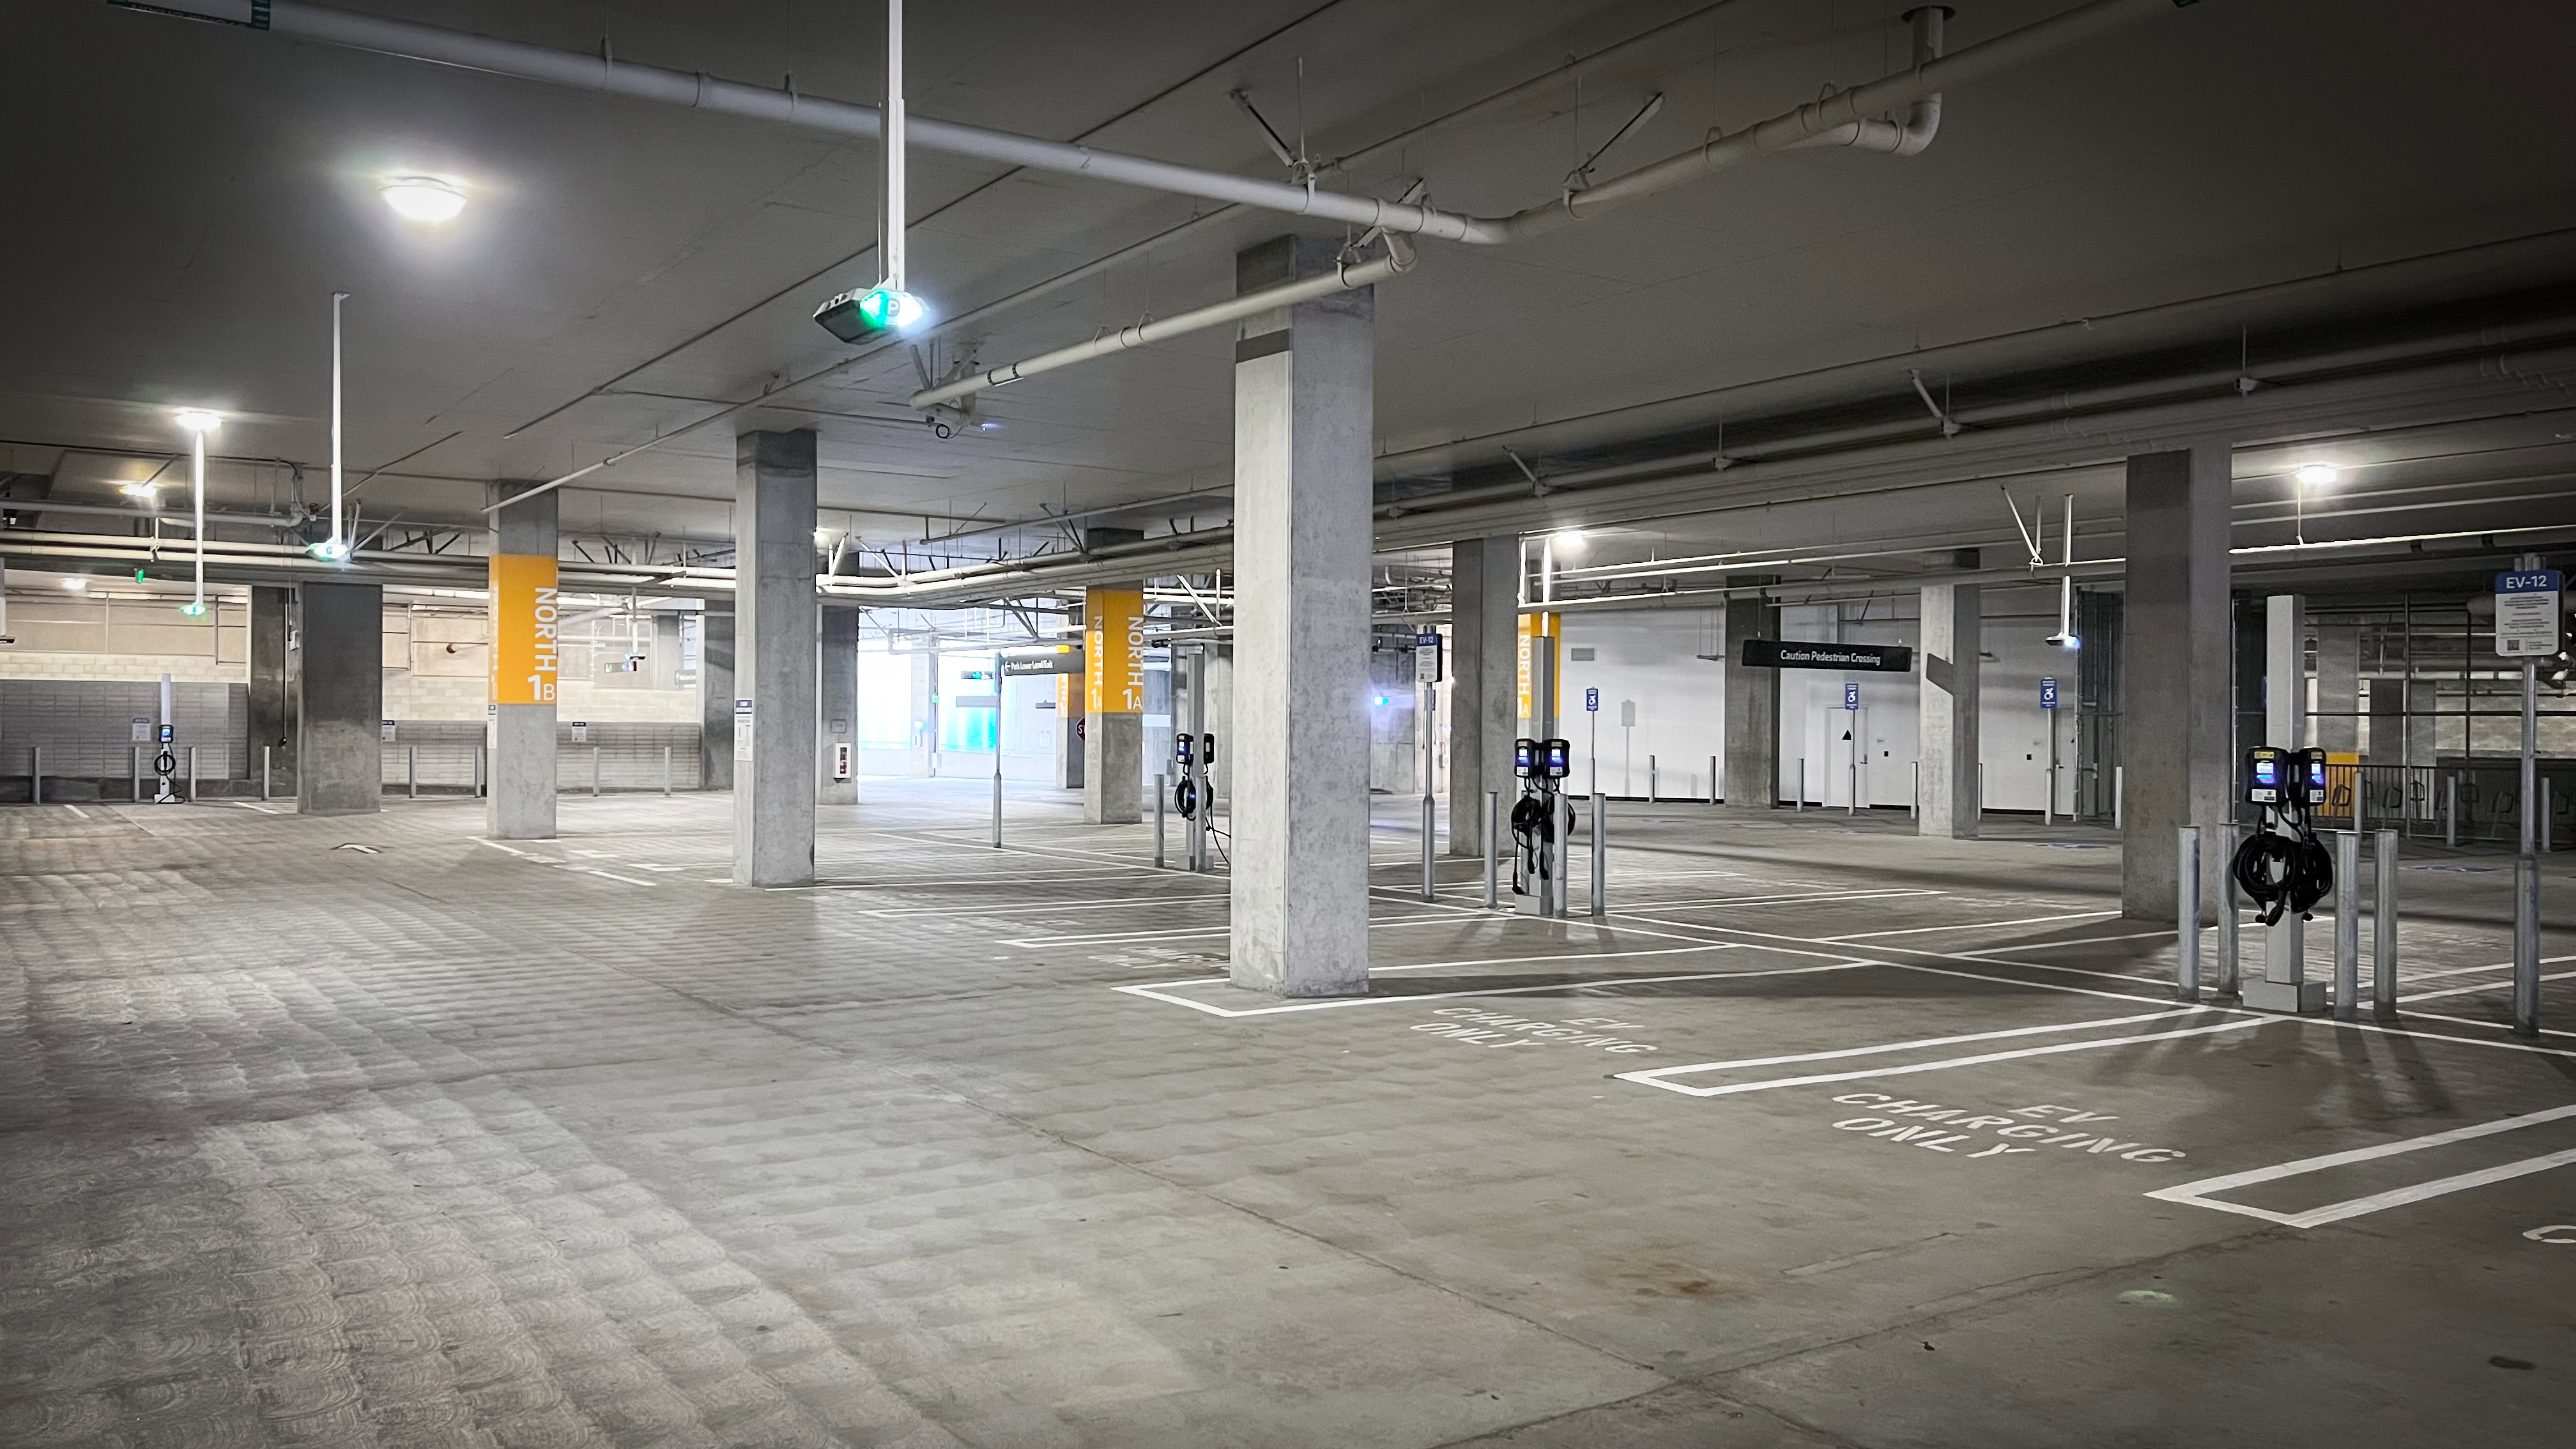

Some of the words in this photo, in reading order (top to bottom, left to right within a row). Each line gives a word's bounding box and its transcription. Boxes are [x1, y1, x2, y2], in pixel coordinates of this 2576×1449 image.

[2506, 575, 2547, 588] EV-12
[534, 587, 558, 671] NORTH
[1093, 615, 1103, 686] NORTH
[1128, 617, 1144, 686] NORTH
[1519, 634, 1531, 695] NORTH
[1780, 649, 1810, 661] Caution
[1811, 650, 1850, 662] Pedestrian
[1851, 652, 1881, 666] Crossing
[527, 674, 556, 701] 1B
[1123, 688, 1143, 710] 1A
[1409, 1022, 1546, 1048] ONLY
[1432, 1008, 1659, 1053] CHARGING
[1560, 1017, 1646, 1029] EV
[1832, 1093, 2186, 1162] CHARGING
[2006, 1105, 2121, 1123] EV
[1832, 1117, 2038, 1158] ONLY
